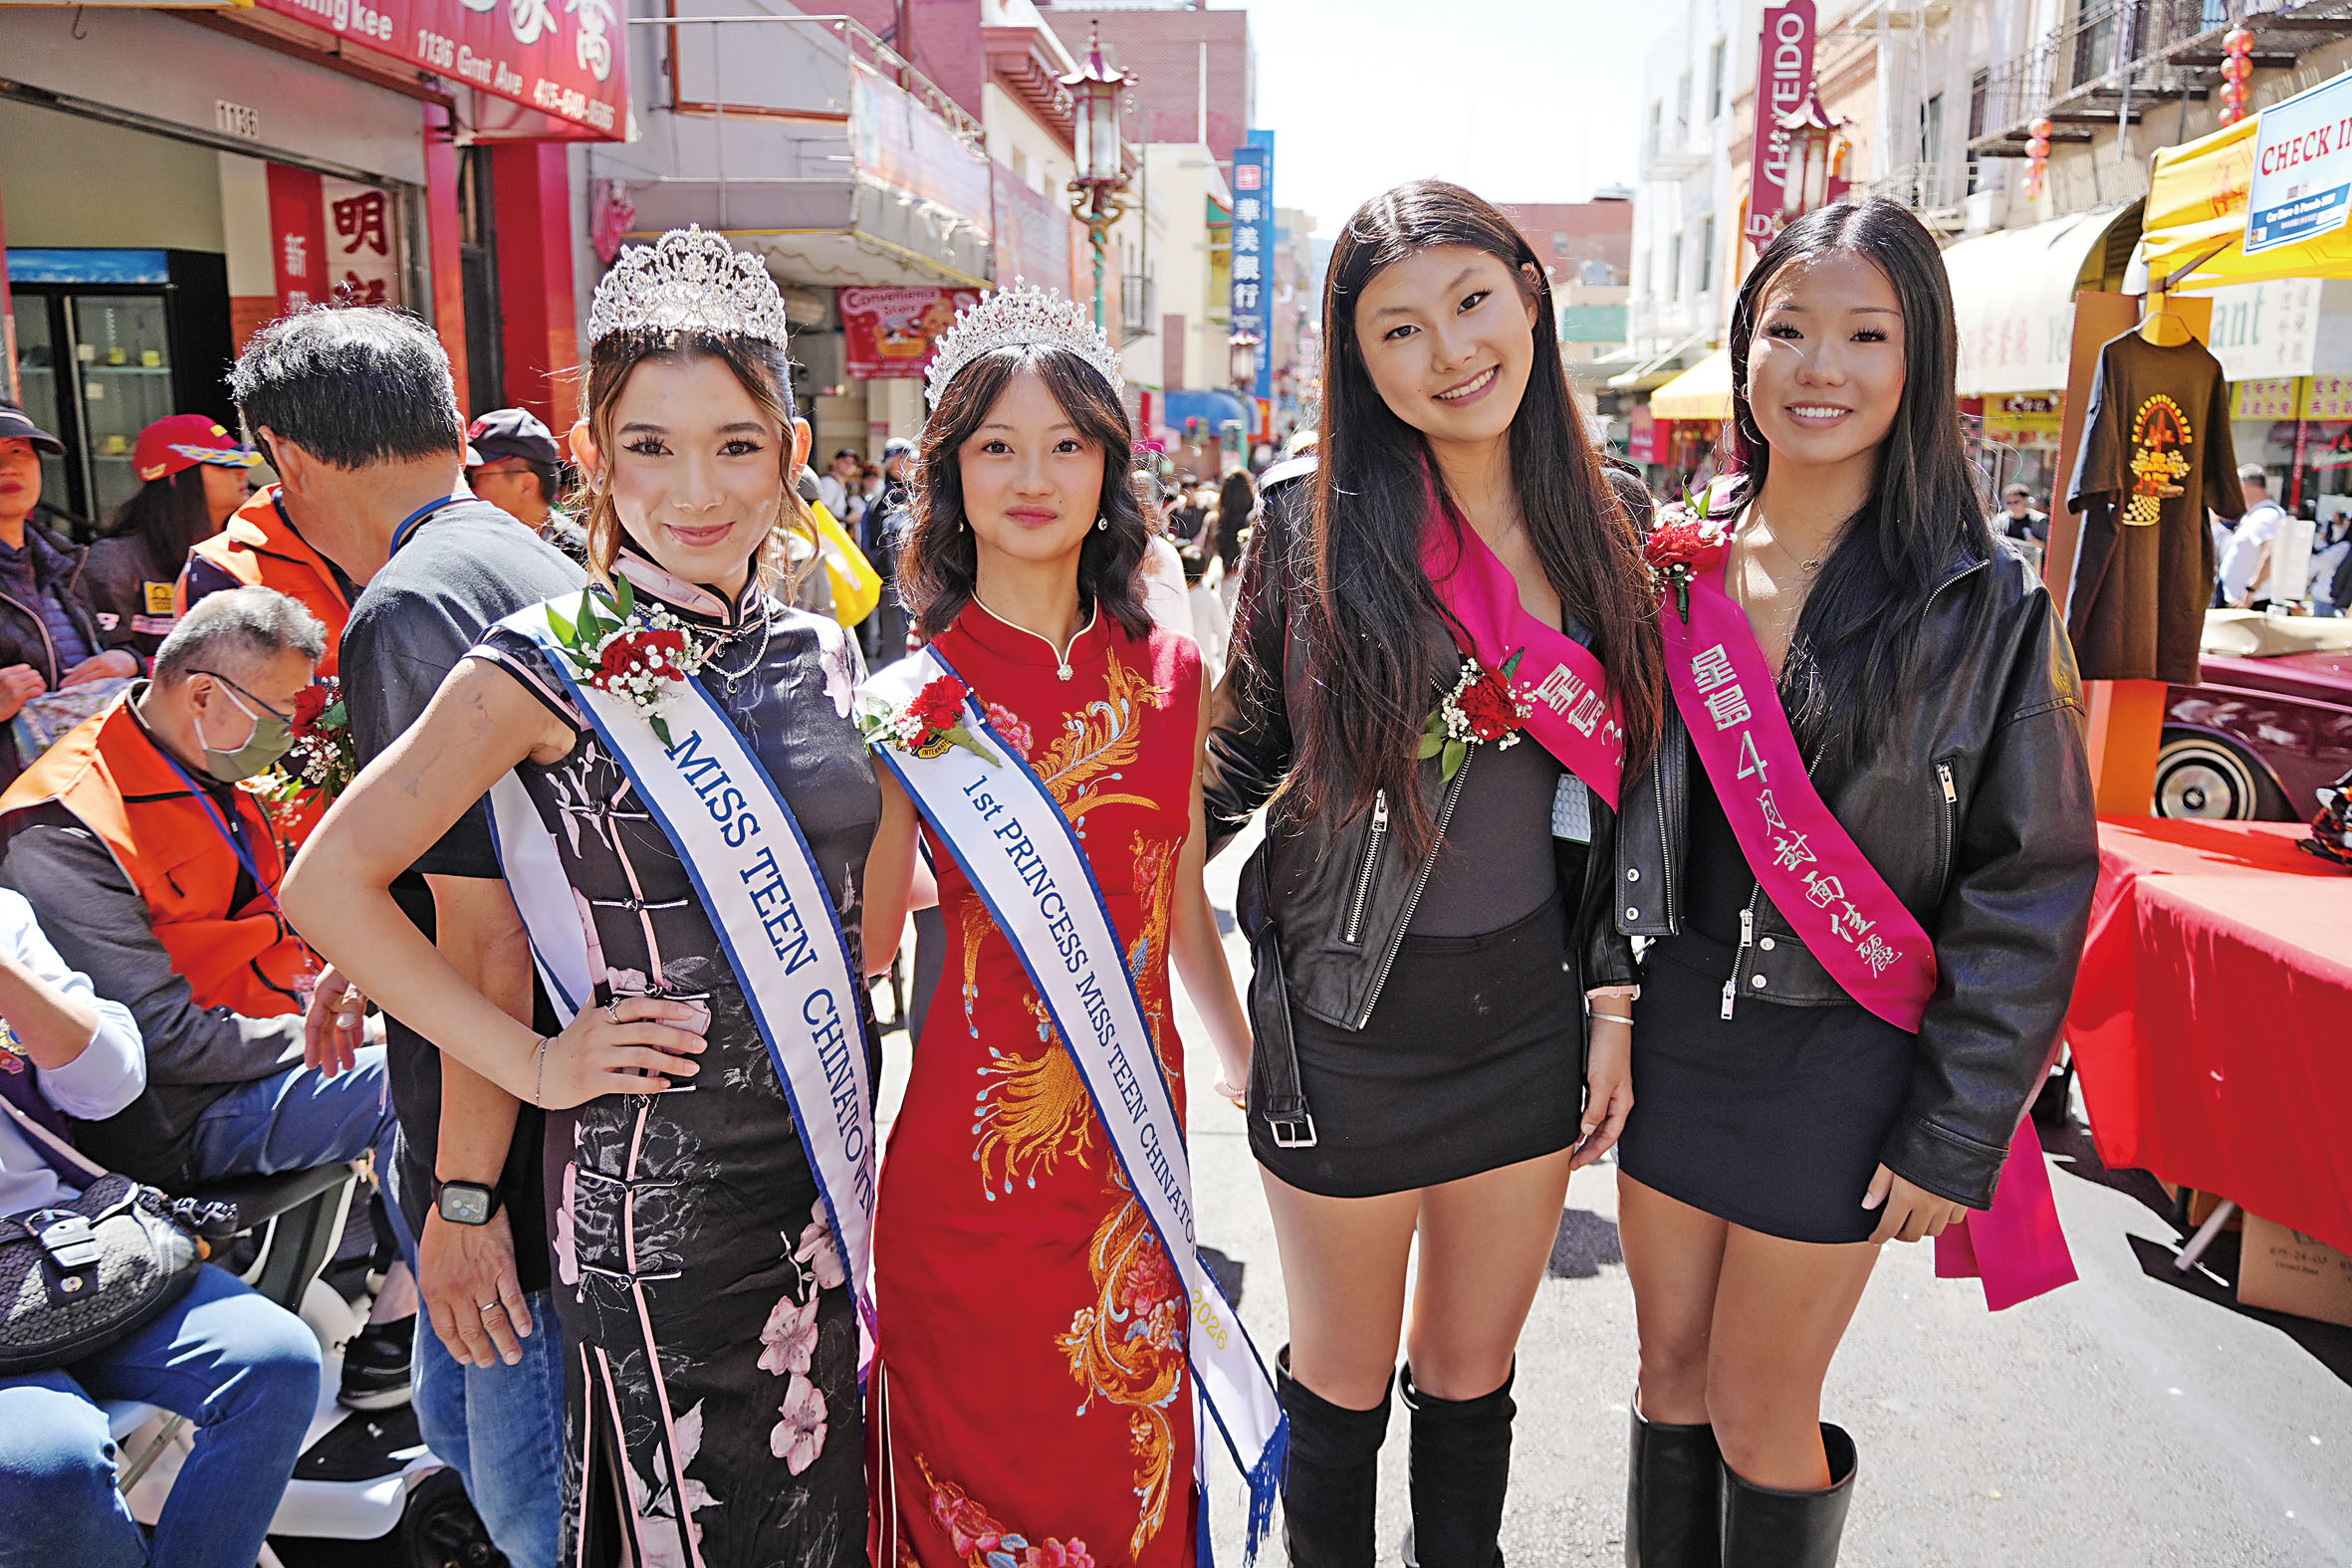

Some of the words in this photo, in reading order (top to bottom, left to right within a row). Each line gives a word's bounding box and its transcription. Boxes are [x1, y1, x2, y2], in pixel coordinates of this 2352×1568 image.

[417, 29, 454, 69] 1136
[219, 104, 256, 137] 1136
[2261, 124, 2332, 176] CHECK
[2337, 116, 2352, 150] I
[1233, 197, 1263, 310] 華美銀行
[1536, 662, 1627, 772] 星島3
[663, 729, 762, 848] MISS
[739, 846, 819, 977] TEEN
[803, 988, 876, 1221] CHINATOWN
[962, 775, 1004, 822] 1st
[993, 816, 1089, 975] PRINCESS
[1075, 971, 1117, 1047] MISS
[1106, 1042, 1148, 1125] TEEN
[1139, 1122, 1196, 1257] CHINATO
[1191, 1289, 1228, 1351] 2026
